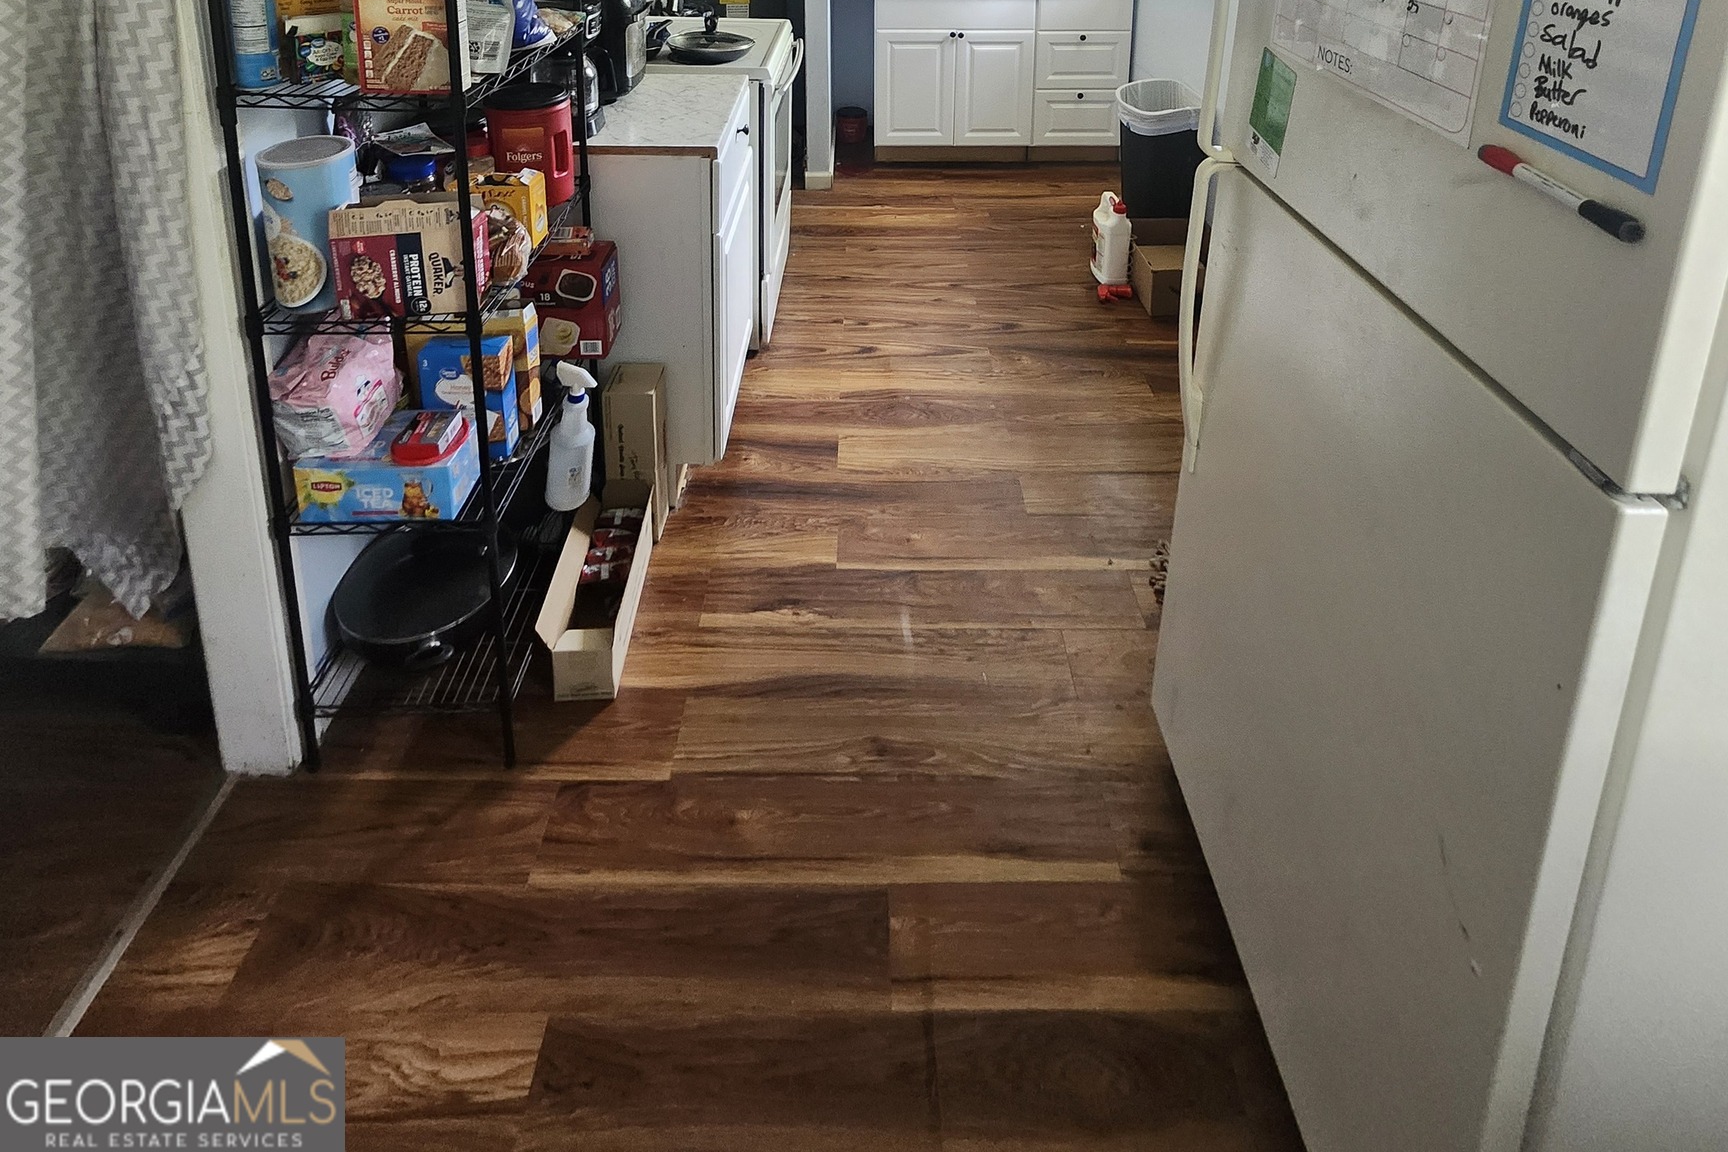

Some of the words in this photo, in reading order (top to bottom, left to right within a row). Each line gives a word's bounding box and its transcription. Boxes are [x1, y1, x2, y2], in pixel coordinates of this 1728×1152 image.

[387, 5, 424, 15] Carrot
[1551, 2, 1614, 32] oranges
[1317, 45, 1353, 75] NOTES:
[1540, 23, 1602, 70] Salad
[1538, 53, 1573, 80] Milk
[1534, 75, 1588, 106] Butter
[1529, 100, 1587, 140] Pepperoni
[506, 151, 543, 164] Folgers
[409, 253, 423, 297] PROTEIN
[428, 252, 444, 295] QUAKER
[539, 293, 551, 302] 18
[422, 359, 429, 367] 3
[356, 488, 394, 499] ICED
[362, 499, 393, 509] TEA
